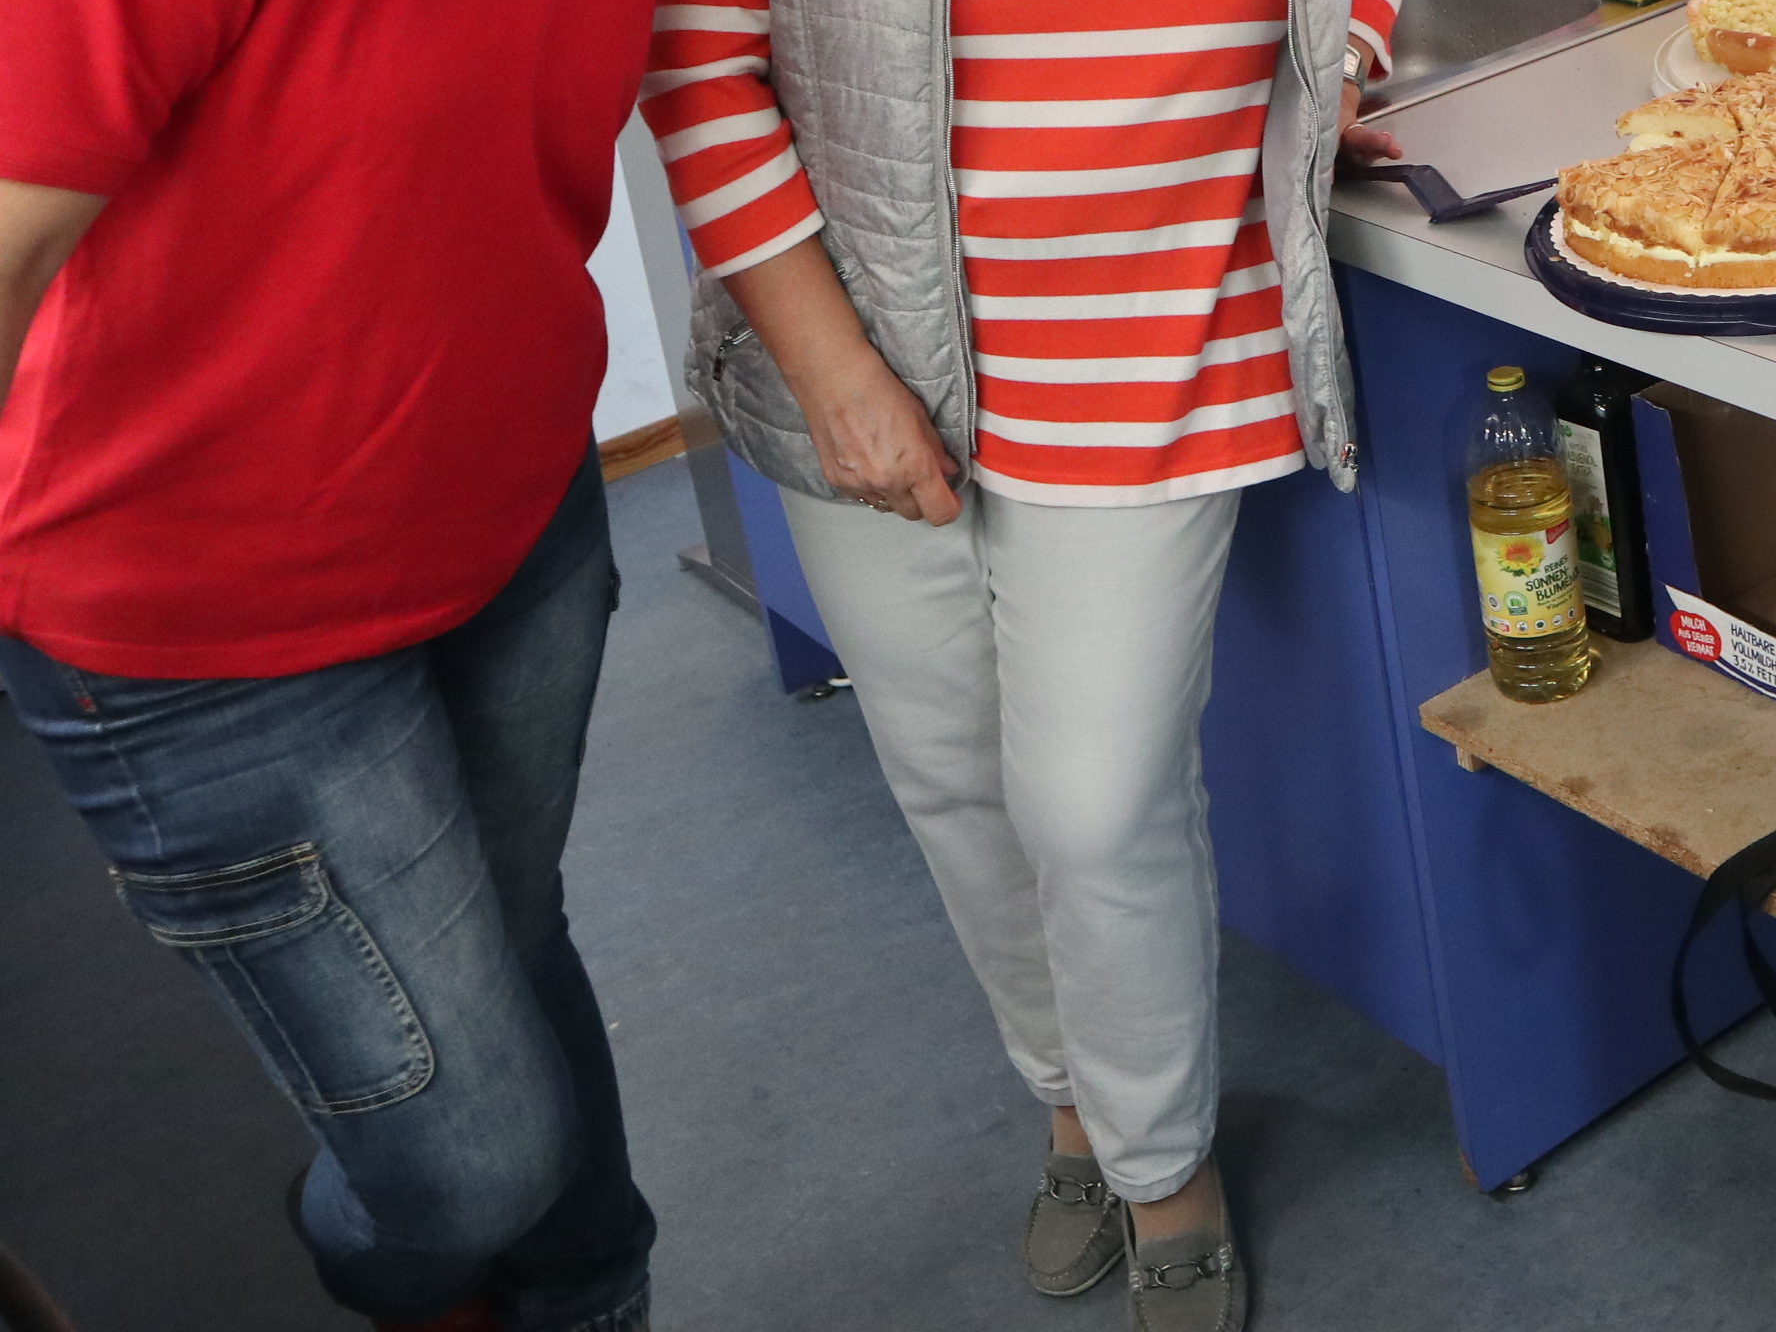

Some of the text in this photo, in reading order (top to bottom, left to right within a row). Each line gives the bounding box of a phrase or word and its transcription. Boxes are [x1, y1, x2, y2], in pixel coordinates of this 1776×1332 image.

[1544, 554, 1568, 573] REINES
[1680, 615, 1706, 632] MILCH
[1686, 640, 1715, 657] HEIMAT
[1730, 623, 1776, 656] HALTBARE
